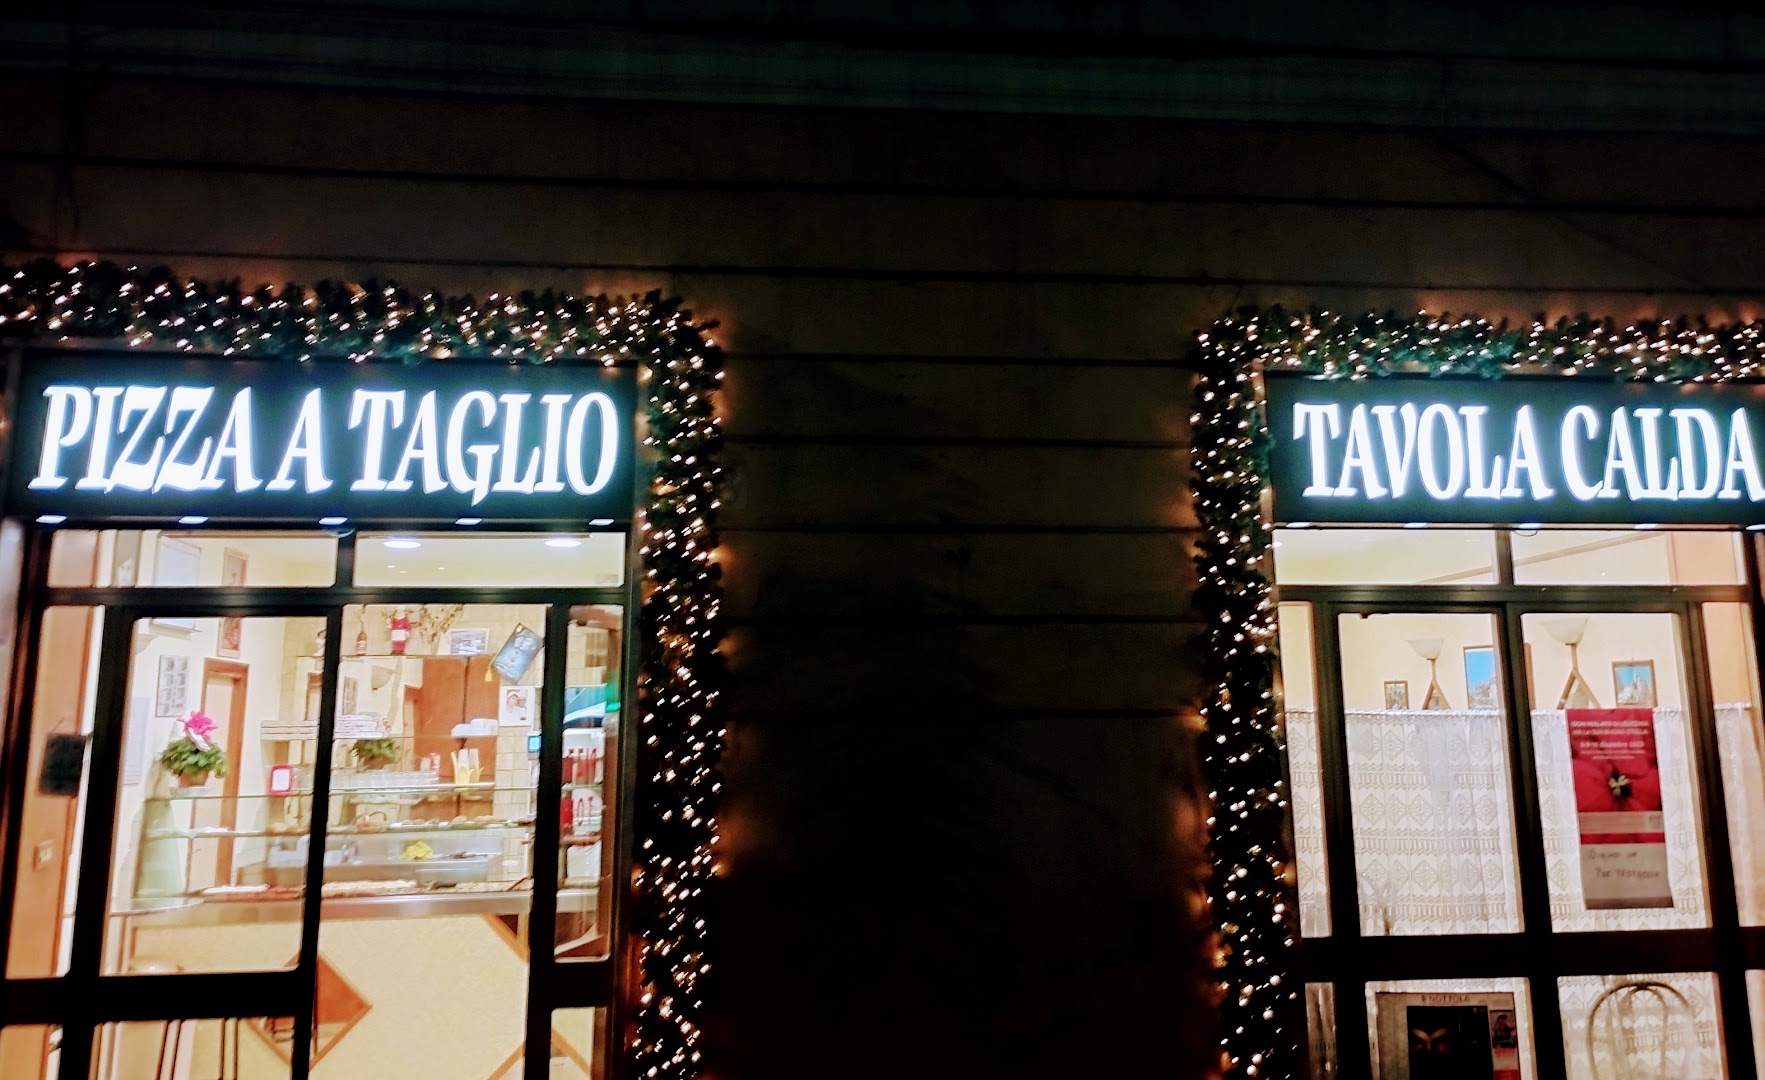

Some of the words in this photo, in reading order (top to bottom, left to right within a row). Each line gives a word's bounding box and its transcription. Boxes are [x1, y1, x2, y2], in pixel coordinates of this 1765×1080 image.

[28, 384, 263, 494] PIZZA
[266, 387, 334, 492] A
[347, 388, 620, 506] TAGLIO
[1292, 402, 1557, 500] TAVOLA
[1560, 405, 1765, 502] CALDA
